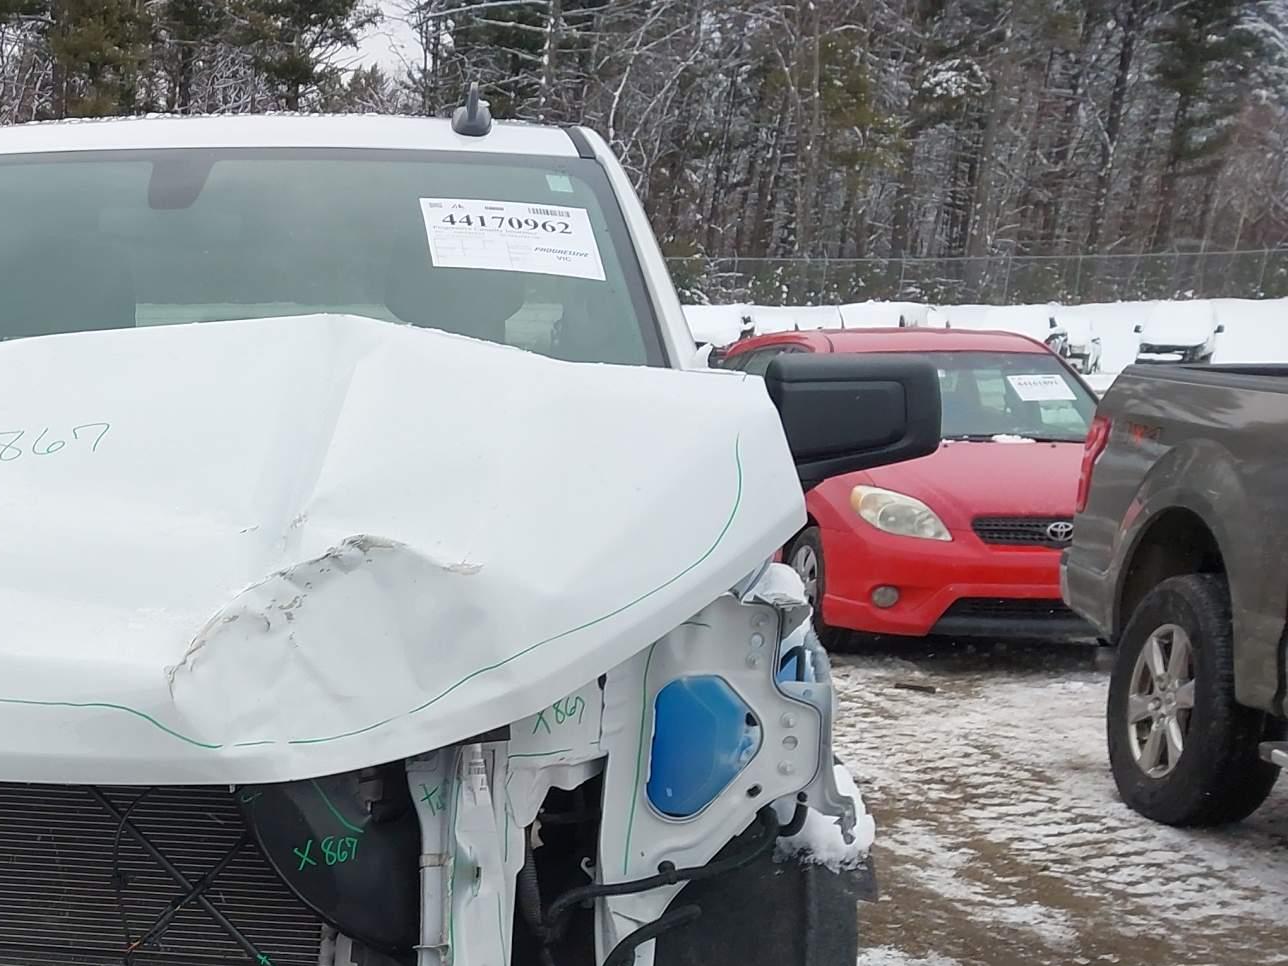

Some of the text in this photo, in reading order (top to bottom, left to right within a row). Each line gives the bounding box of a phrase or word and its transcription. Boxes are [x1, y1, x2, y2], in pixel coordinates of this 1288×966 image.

[442, 212, 573, 235] 44170962
[294, 835, 359, 871] X 867
